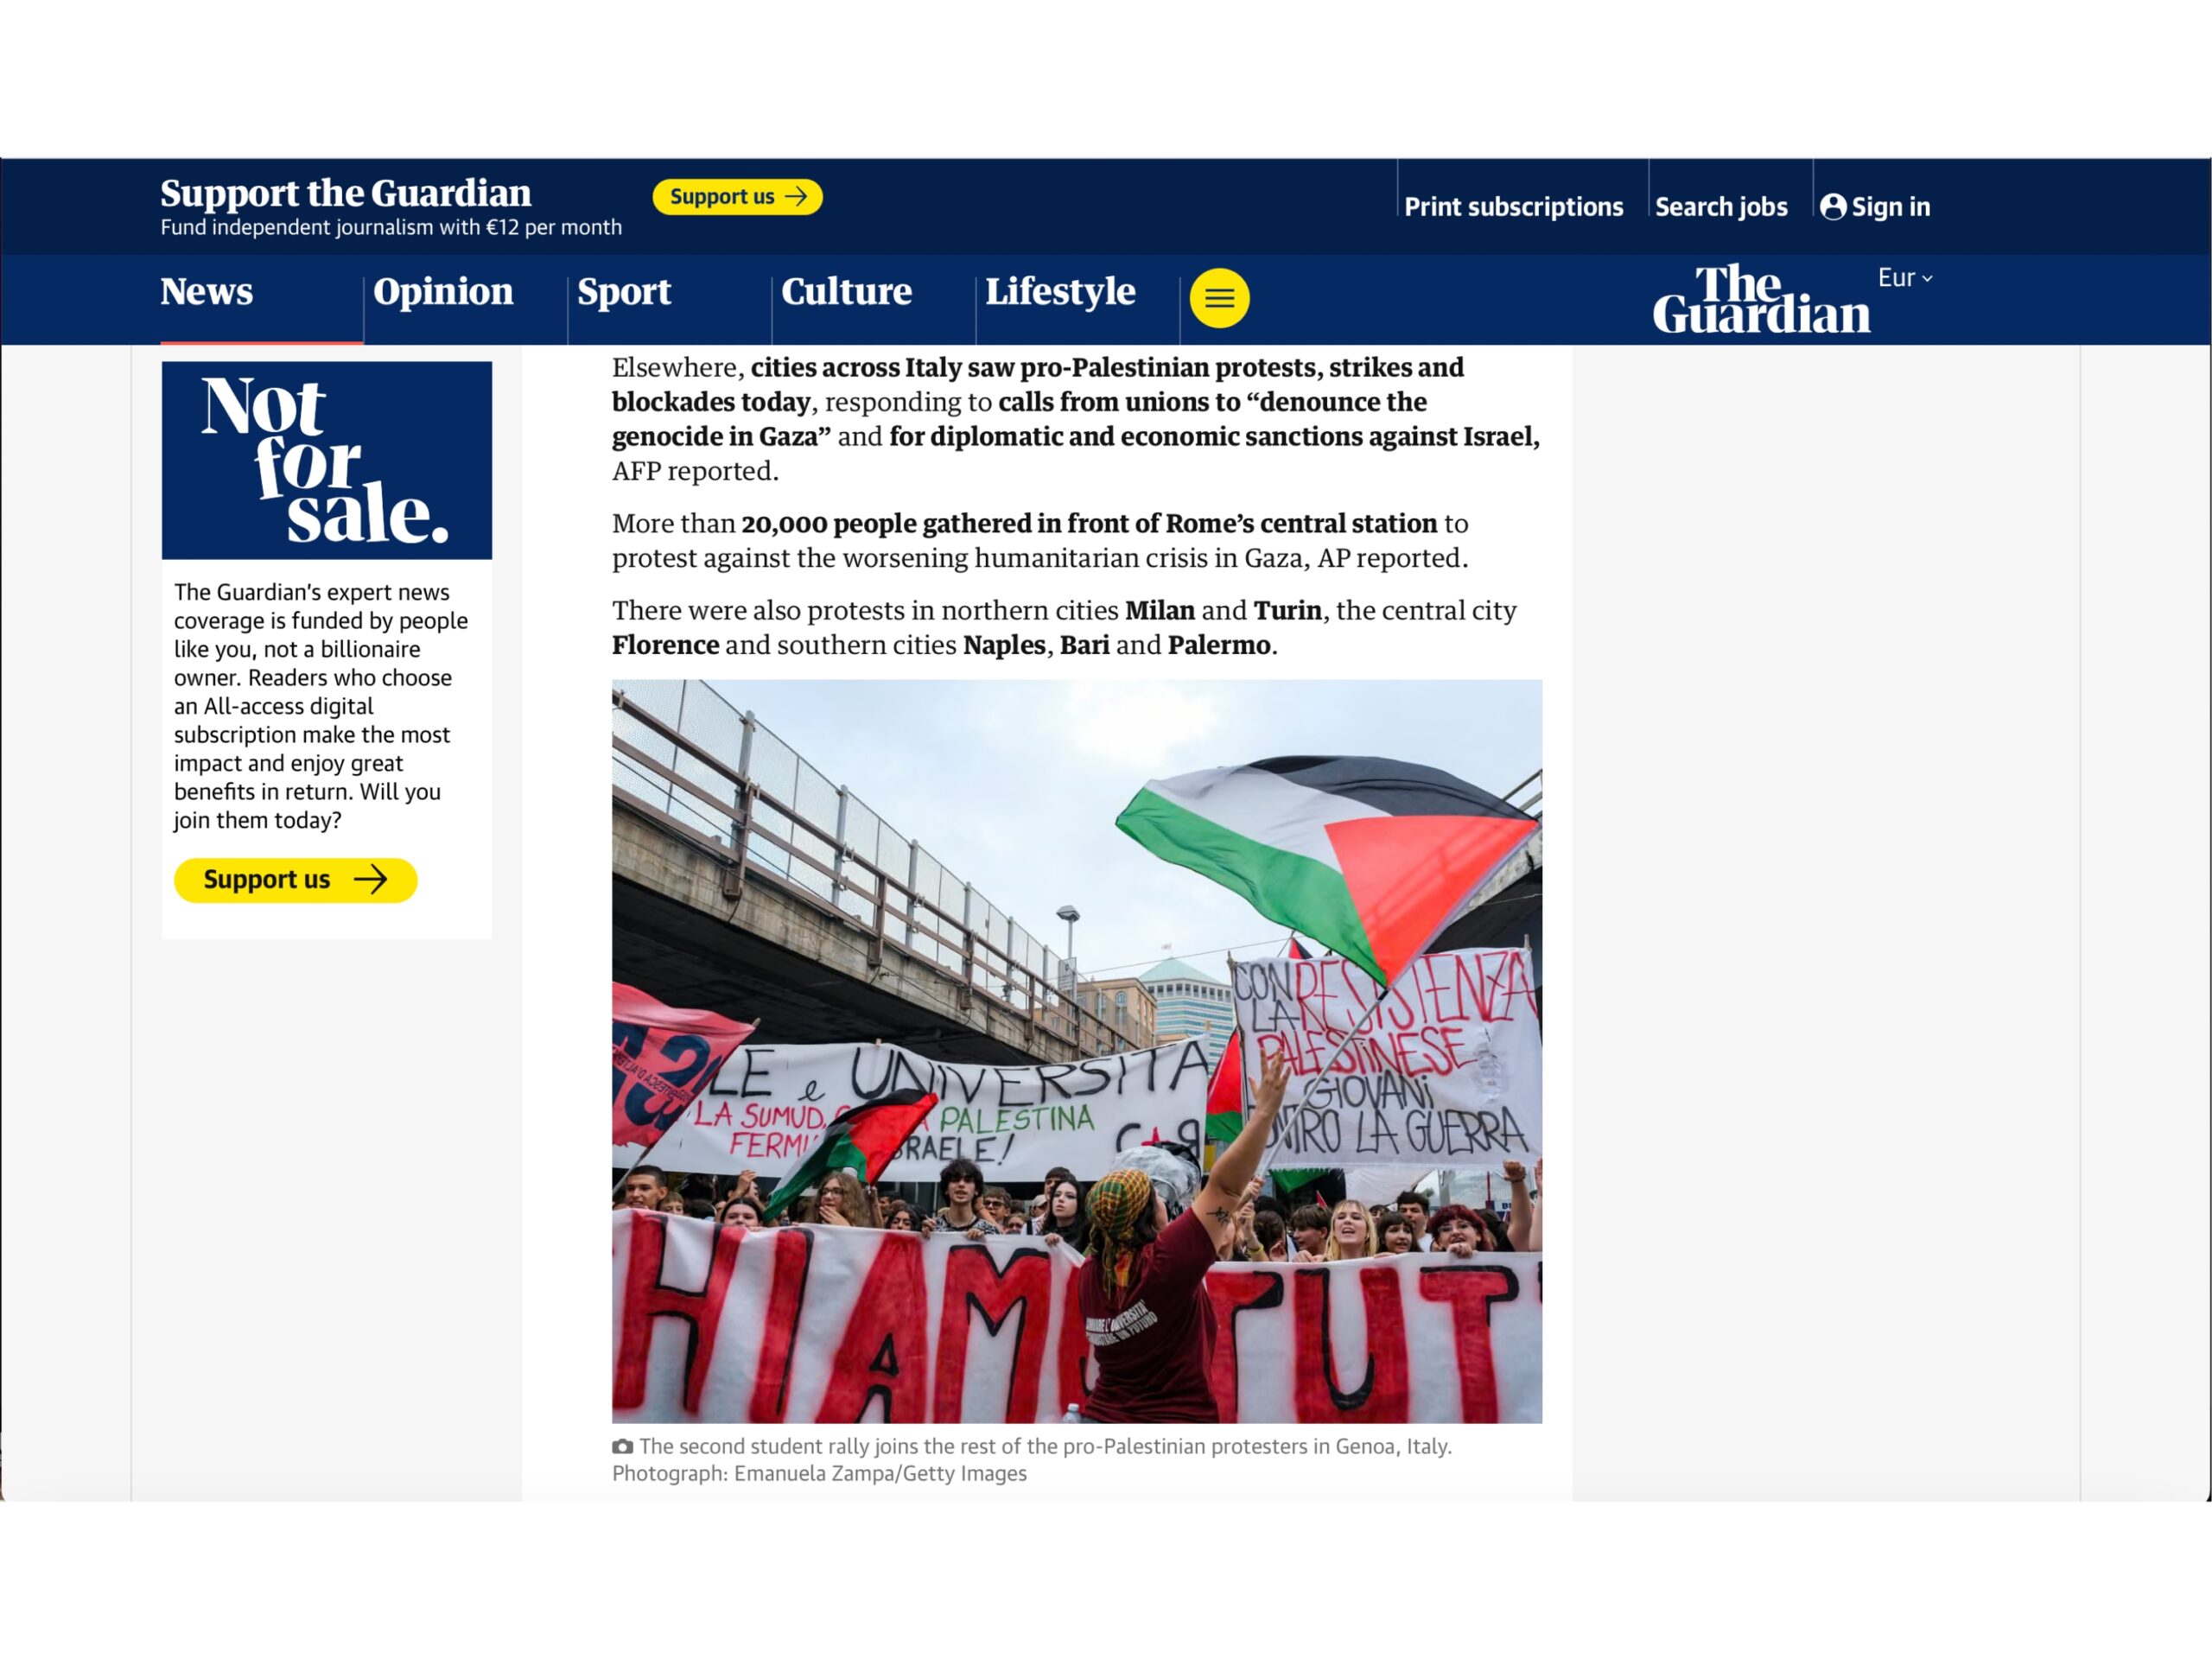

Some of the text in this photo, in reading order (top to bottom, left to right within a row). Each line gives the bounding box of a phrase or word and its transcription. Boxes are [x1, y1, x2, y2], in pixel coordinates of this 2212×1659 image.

[161, 176, 533, 215] Support the Guardian
[671, 188, 775, 209] Support us
[1405, 195, 1624, 222] Print subscriptions
[1656, 195, 1789, 222] Search jobs
[1853, 195, 1930, 222] Sign in
[162, 217, 622, 240] Fund independent journalism with €12 per month
[160, 277, 254, 306] News
[781, 275, 912, 306] Culture
[1696, 264, 1782, 302] The
[1879, 267, 1916, 288] Eur
[373, 275, 515, 313] Opinion
[578, 276, 672, 313] Sport
[985, 275, 1136, 314] Lifestyle
[1652, 289, 1872, 334] Guardian
[613, 355, 1465, 383] Elsewhere, cities across Italy saw pro-Palestinian protests, strikes and
[201, 377, 327, 435] Not
[611, 390, 1428, 418] blockades today, responding to calls from unions to “denounce the
[254, 436, 362, 500] for
[288, 480, 449, 544] sale.
[612, 512, 1469, 539] More than 20,000 people gathered in front of Rome’s central station to
[174, 582, 450, 606] The Guardian's expert news
[174, 610, 468, 634] coverage is funded by people
[612, 598, 1518, 626] There were also protests in northern cities Milan and Turin, the central city
[612, 632, 1278, 661] Florence and southern cities Naples, Bari and Palermo.
[174, 667, 453, 687] owner. Readers who choose
[174, 724, 451, 748] subscription make the most
[175, 781, 441, 805] benefits in return. Will you
[172, 810, 342, 834] join them today?
[204, 868, 331, 894] Support us
[1234, 961, 1292, 1001] CON
[1252, 997, 1300, 1033] LA
[694, 1100, 732, 1127] LA
[940, 1103, 1095, 1135] PALESTINA
[1357, 1109, 1399, 1154] LA
[1405, 1106, 1530, 1155] GUERRA
[1205, 1263, 1542, 1423] TUT
[639, 1436, 1452, 1459] The second student rally joins the rest of the pro-Palestinian protesters in Genoa, Italy.
[613, 1464, 1027, 1486] Photograph: Emanuela Zampa/Getty Images
